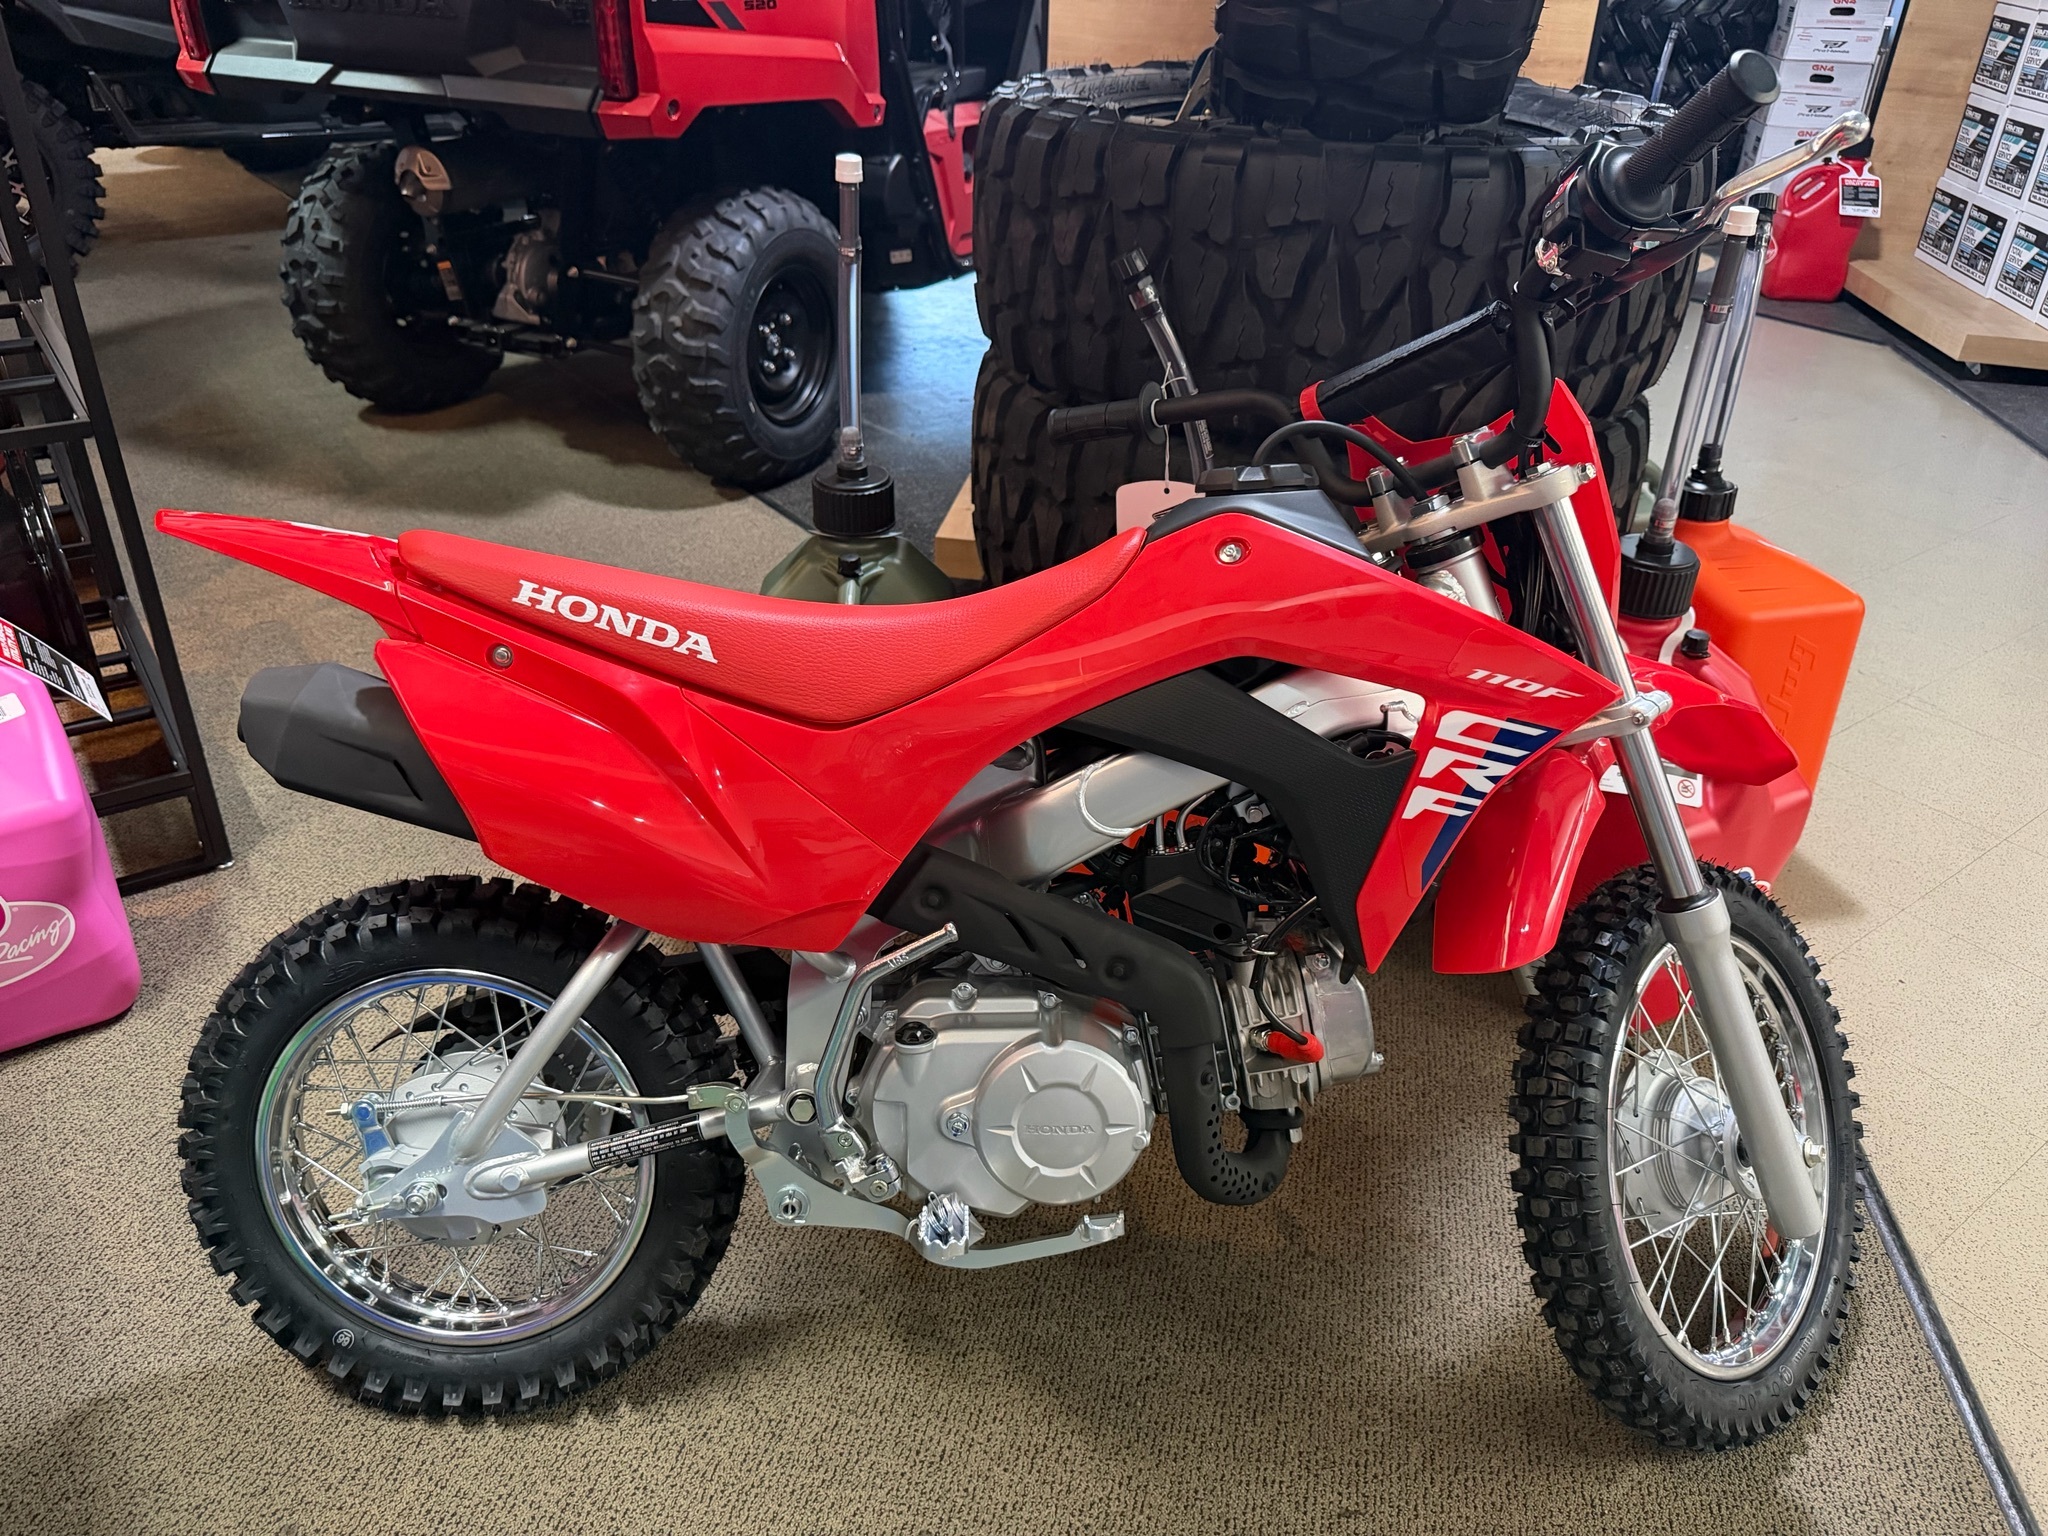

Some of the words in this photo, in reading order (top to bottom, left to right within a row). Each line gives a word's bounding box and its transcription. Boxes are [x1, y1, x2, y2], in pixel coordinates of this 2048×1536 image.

[1812, 64, 1835, 72] GN4
[512, 580, 718, 664] HONDA
[1466, 668, 1585, 698] 110F
[1401, 710, 1548, 820] CRF
[1024, 1124, 1096, 1136] HONDA
